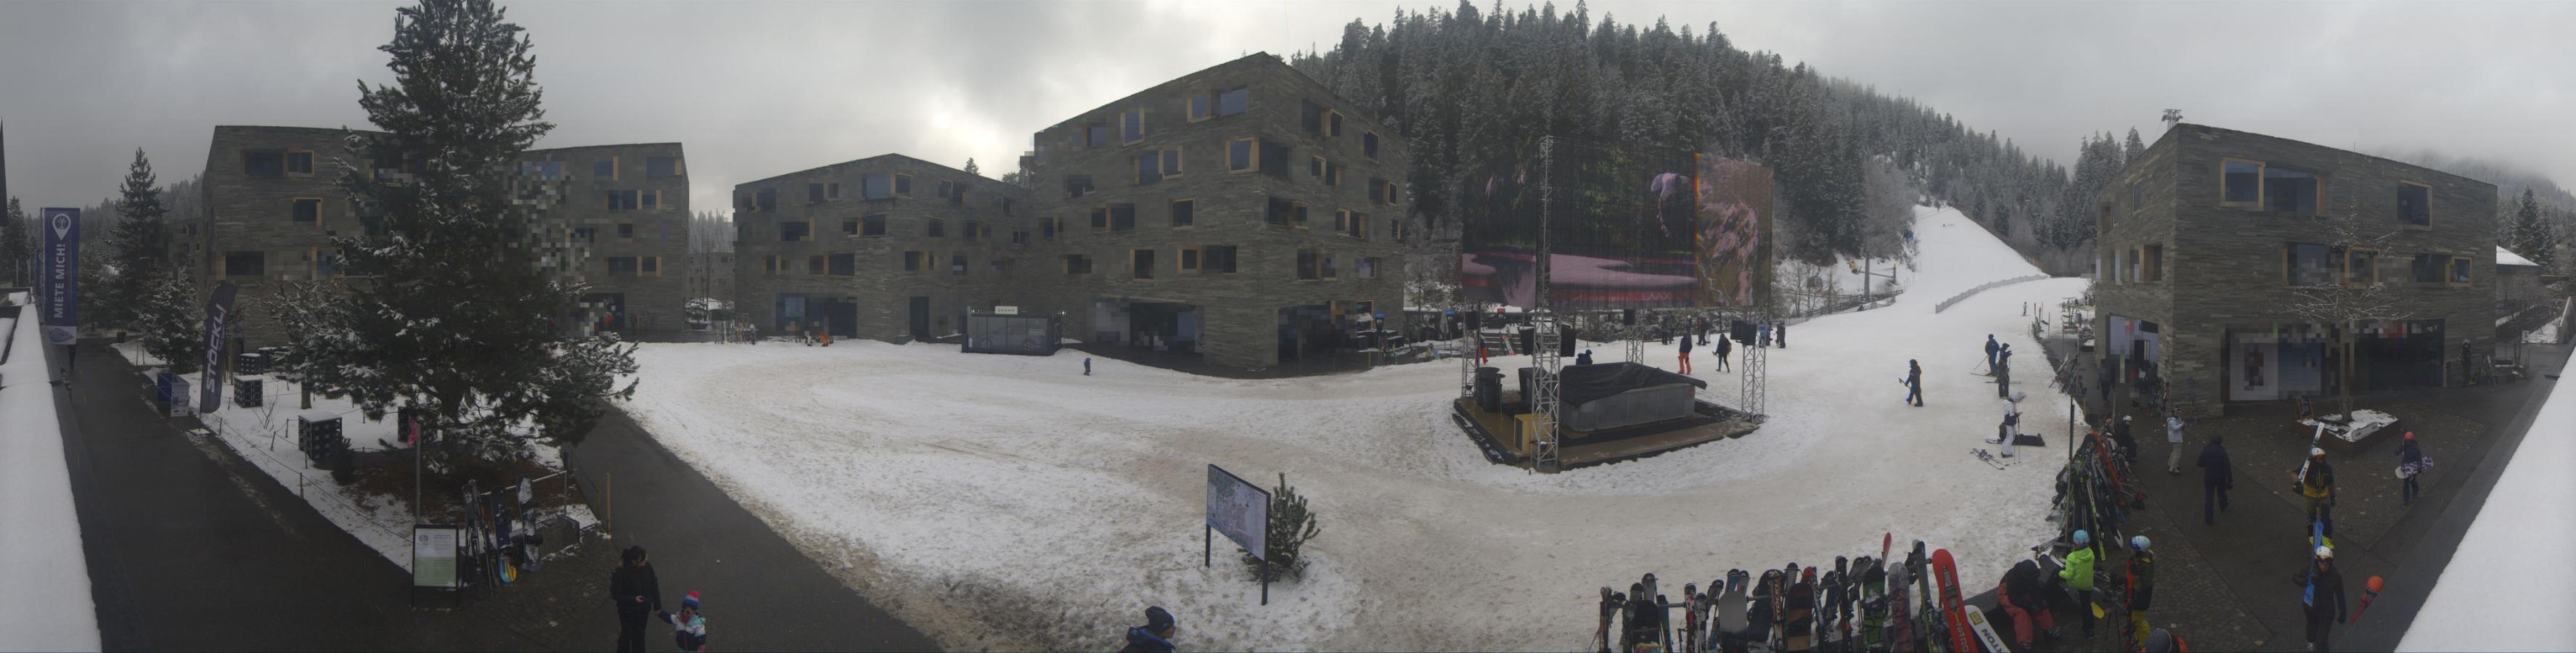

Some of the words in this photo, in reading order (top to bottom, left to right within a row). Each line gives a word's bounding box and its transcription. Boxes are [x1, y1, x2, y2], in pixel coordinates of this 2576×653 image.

[55, 244, 65, 279] MICH!
[54, 282, 64, 318] MIETE
[1642, 292, 1671, 300] LAAX
[206, 303, 228, 393] STÖCKLI
[1955, 623, 1969, 653] NITRO
